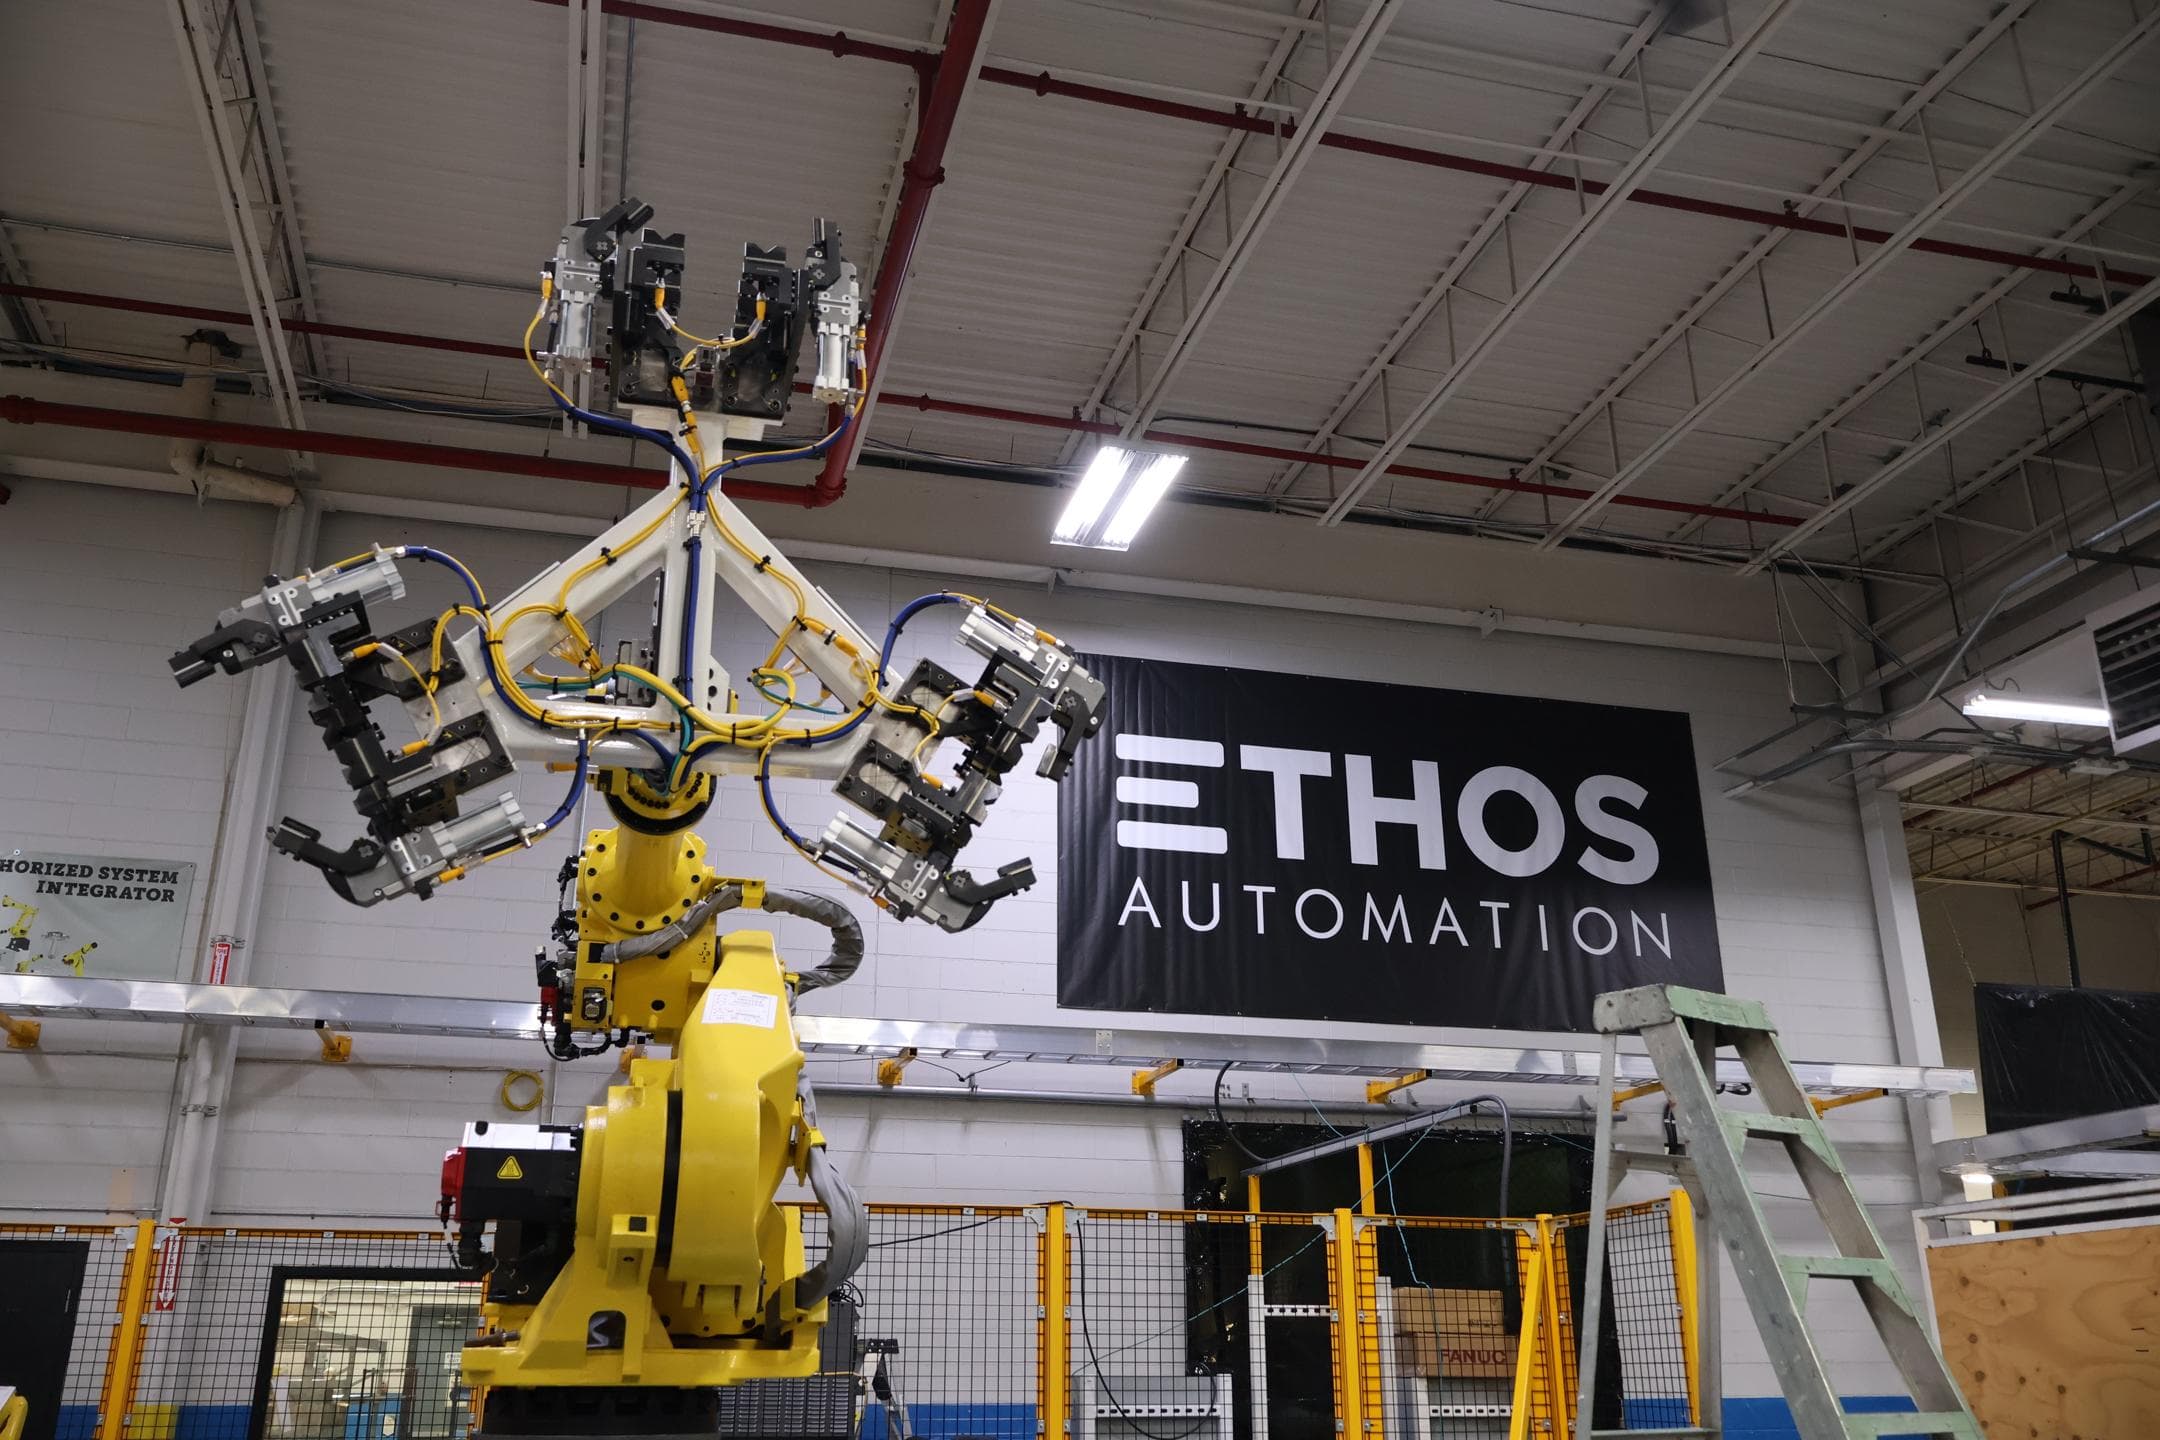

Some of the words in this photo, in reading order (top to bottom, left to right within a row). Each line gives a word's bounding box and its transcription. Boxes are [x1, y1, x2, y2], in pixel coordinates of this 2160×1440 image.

[1116, 734, 1658, 884] ETHOS
[0, 859, 93, 878] HORIZED
[98, 866, 178, 884] SYSTEM
[36, 880, 175, 902] INTEGRATOR
[1118, 876, 1671, 959] AUTOMATION
[1440, 1349, 1506, 1364] FANUC
